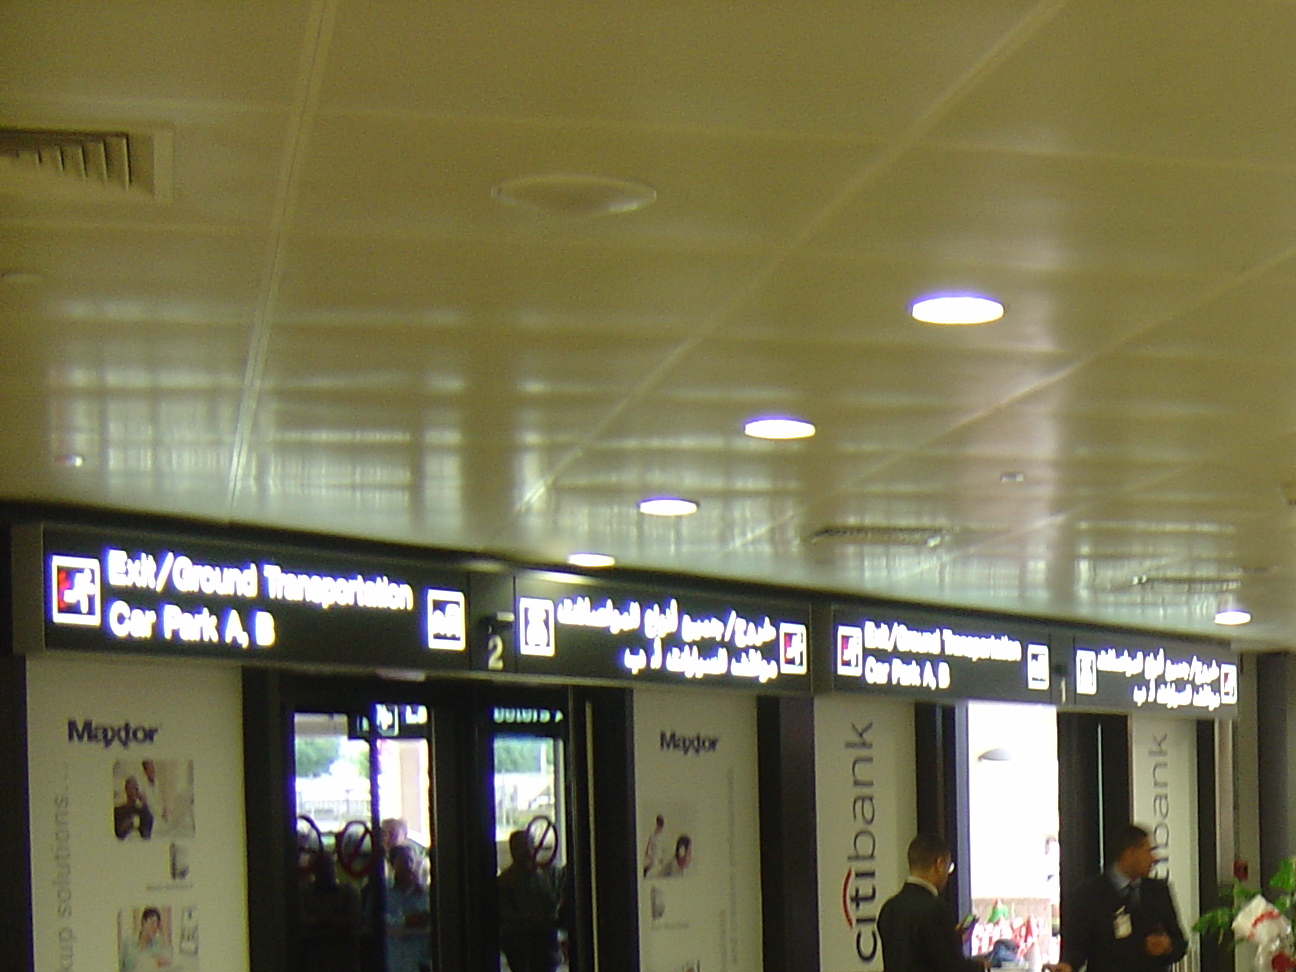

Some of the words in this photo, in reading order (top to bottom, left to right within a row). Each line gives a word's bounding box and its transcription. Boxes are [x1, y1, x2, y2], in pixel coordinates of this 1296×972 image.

[107, 548, 258, 600] Exit/Ground
[263, 564, 414, 611] Transportation
[108, 600, 157, 640] Car
[162, 604, 219, 643] Park
[255, 611, 276, 647] B
[864, 619, 942, 655] Exit/Ground
[942, 627, 1022, 663] Transportation
[487, 635, 503, 670] 2
[865, 655, 889, 686] Car
[891, 657, 921, 688] Park
[937, 661, 951, 689] B
[67, 718, 158, 748] Maxtor
[660, 731, 719, 756] Maxtor
[844, 720, 878, 964] citibank
